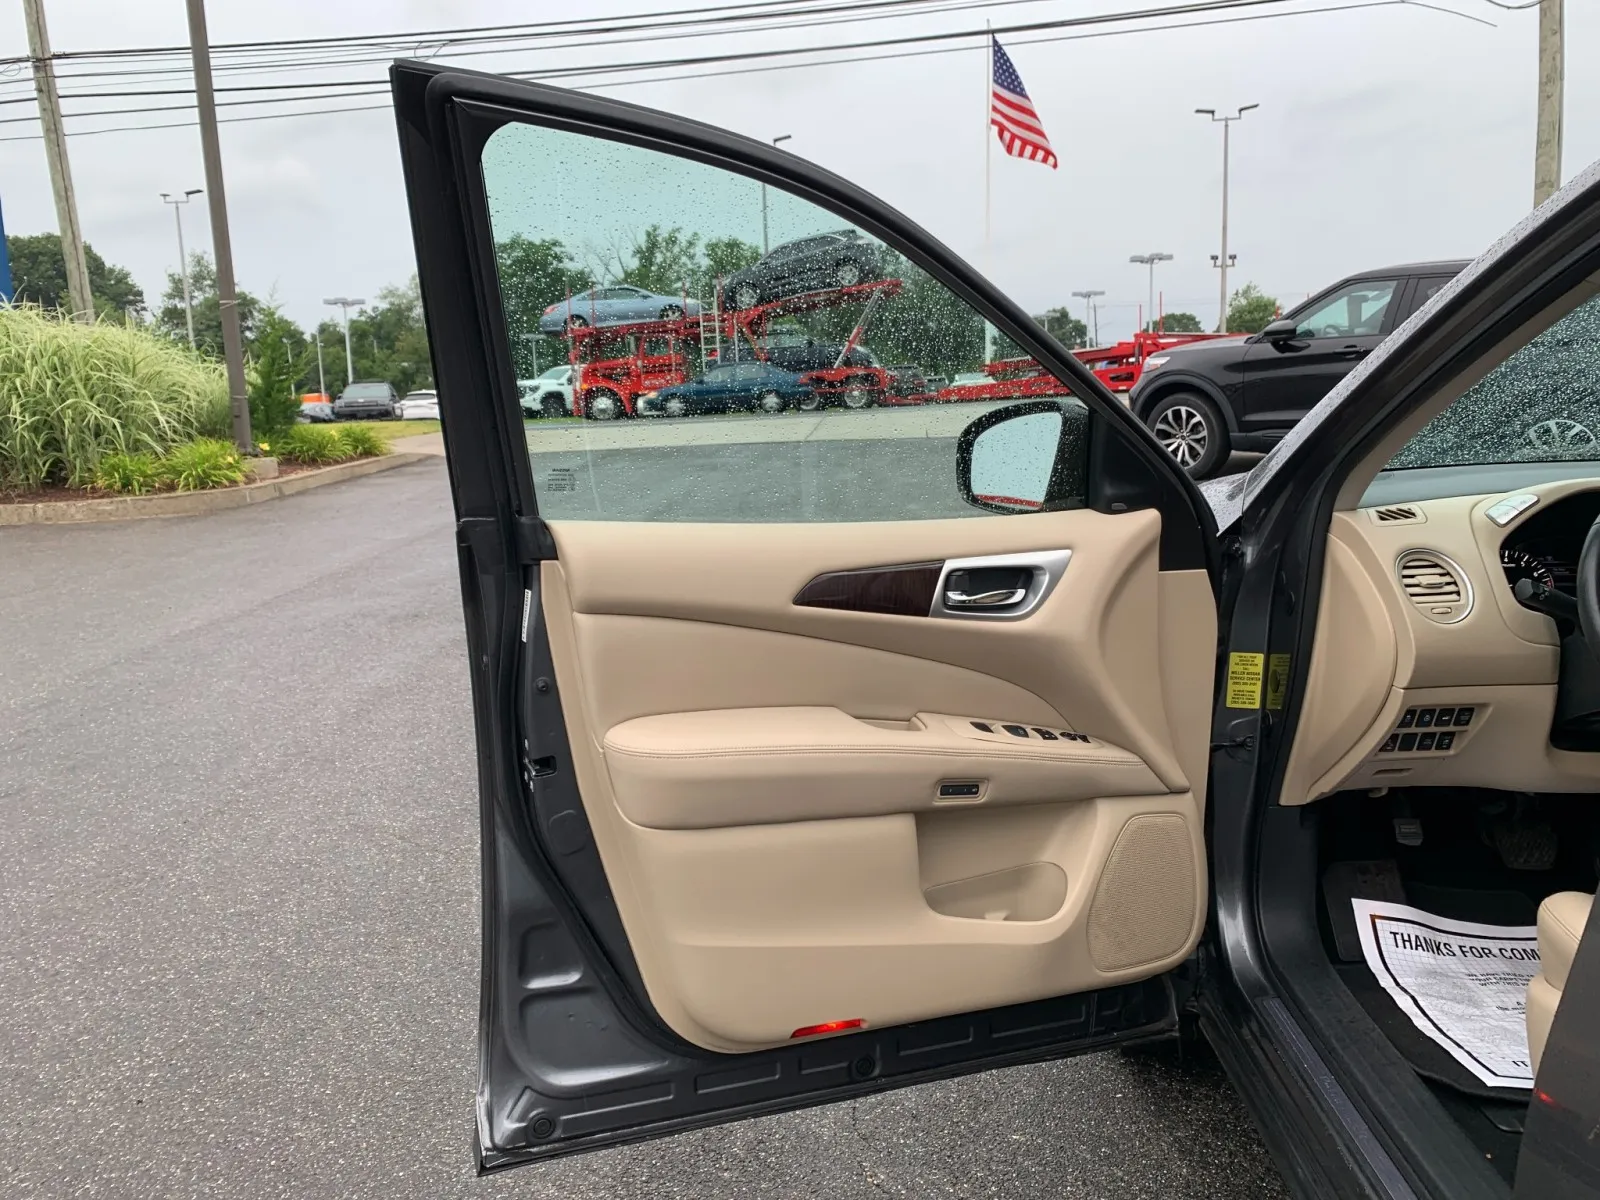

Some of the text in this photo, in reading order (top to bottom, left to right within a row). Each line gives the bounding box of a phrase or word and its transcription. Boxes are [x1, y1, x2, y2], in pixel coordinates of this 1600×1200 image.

[1390, 931, 1541, 961] THANKS FOR COM
